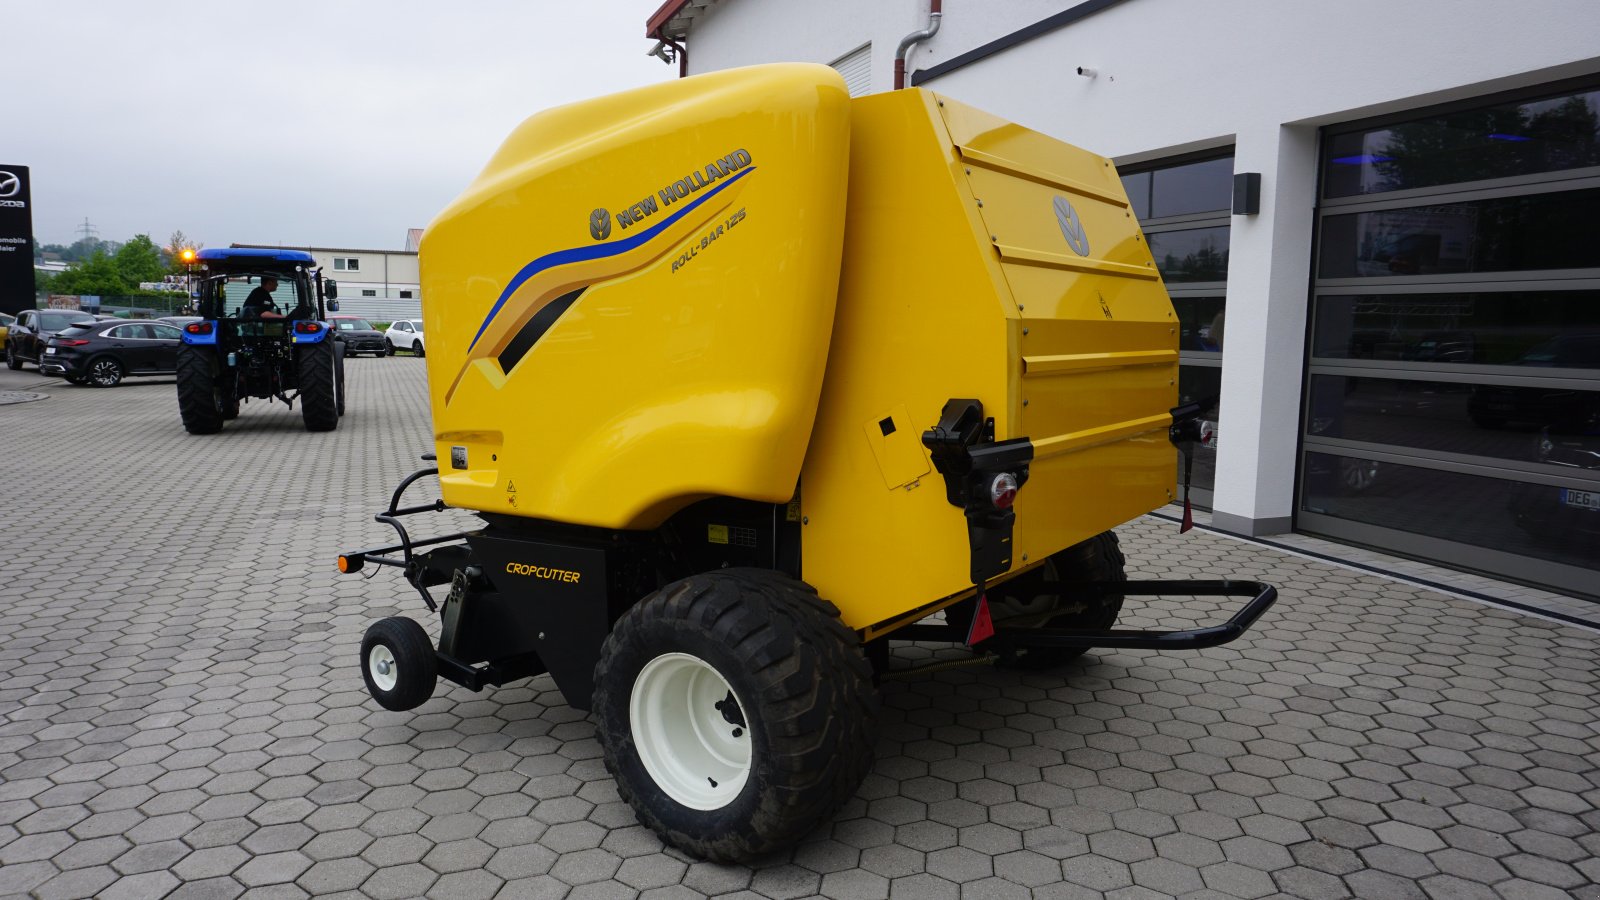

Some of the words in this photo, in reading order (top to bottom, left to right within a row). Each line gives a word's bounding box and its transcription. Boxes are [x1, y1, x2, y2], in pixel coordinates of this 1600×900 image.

[615, 195, 659, 230] NEW
[657, 148, 752, 207] HOLLAND
[671, 224, 724, 274] ROLL-BAR
[725, 206, 747, 230] 125
[506, 562, 581, 584] CROPCUTTER
